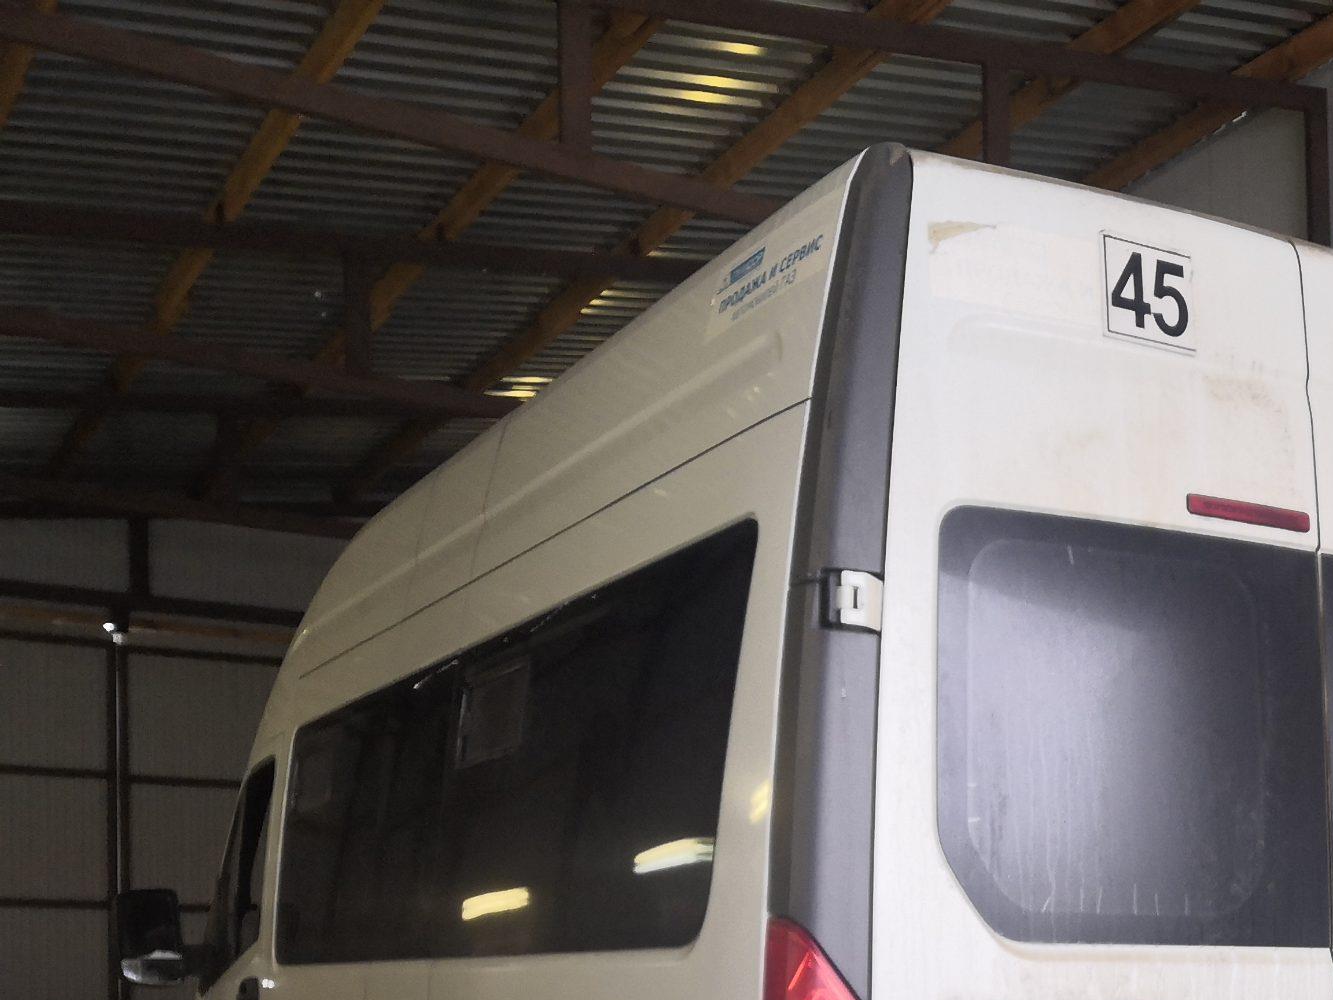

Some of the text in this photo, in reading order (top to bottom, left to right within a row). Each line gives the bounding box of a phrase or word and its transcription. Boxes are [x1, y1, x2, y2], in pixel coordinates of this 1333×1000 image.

[718, 271, 767, 314] ПРОДАЖА
[779, 234, 824, 273] СЕРВИС
[1111, 251, 1189, 337] 45
